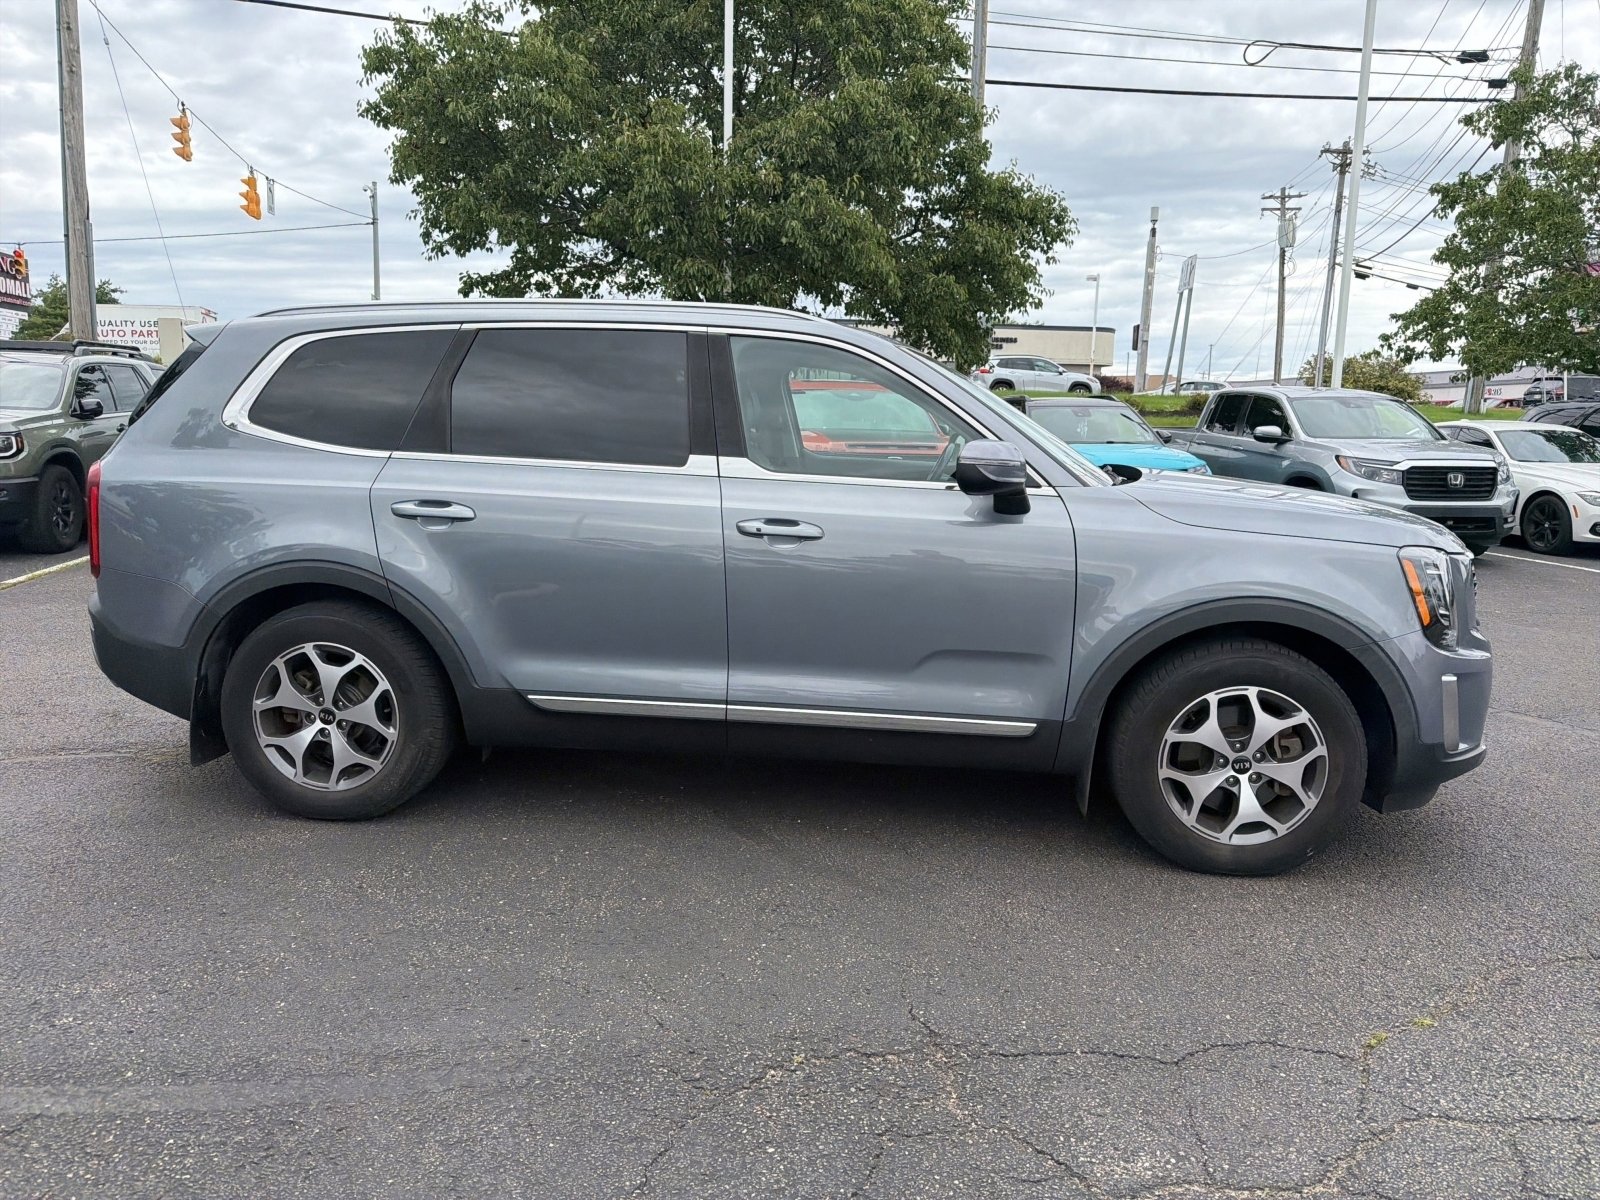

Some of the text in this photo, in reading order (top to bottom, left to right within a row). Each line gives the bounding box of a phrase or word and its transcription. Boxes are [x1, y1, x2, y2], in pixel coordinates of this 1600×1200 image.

[991, 336, 1019, 344] USINESS
[319, 711, 334, 722] KIA
[1233, 761, 1250, 770] KIA
